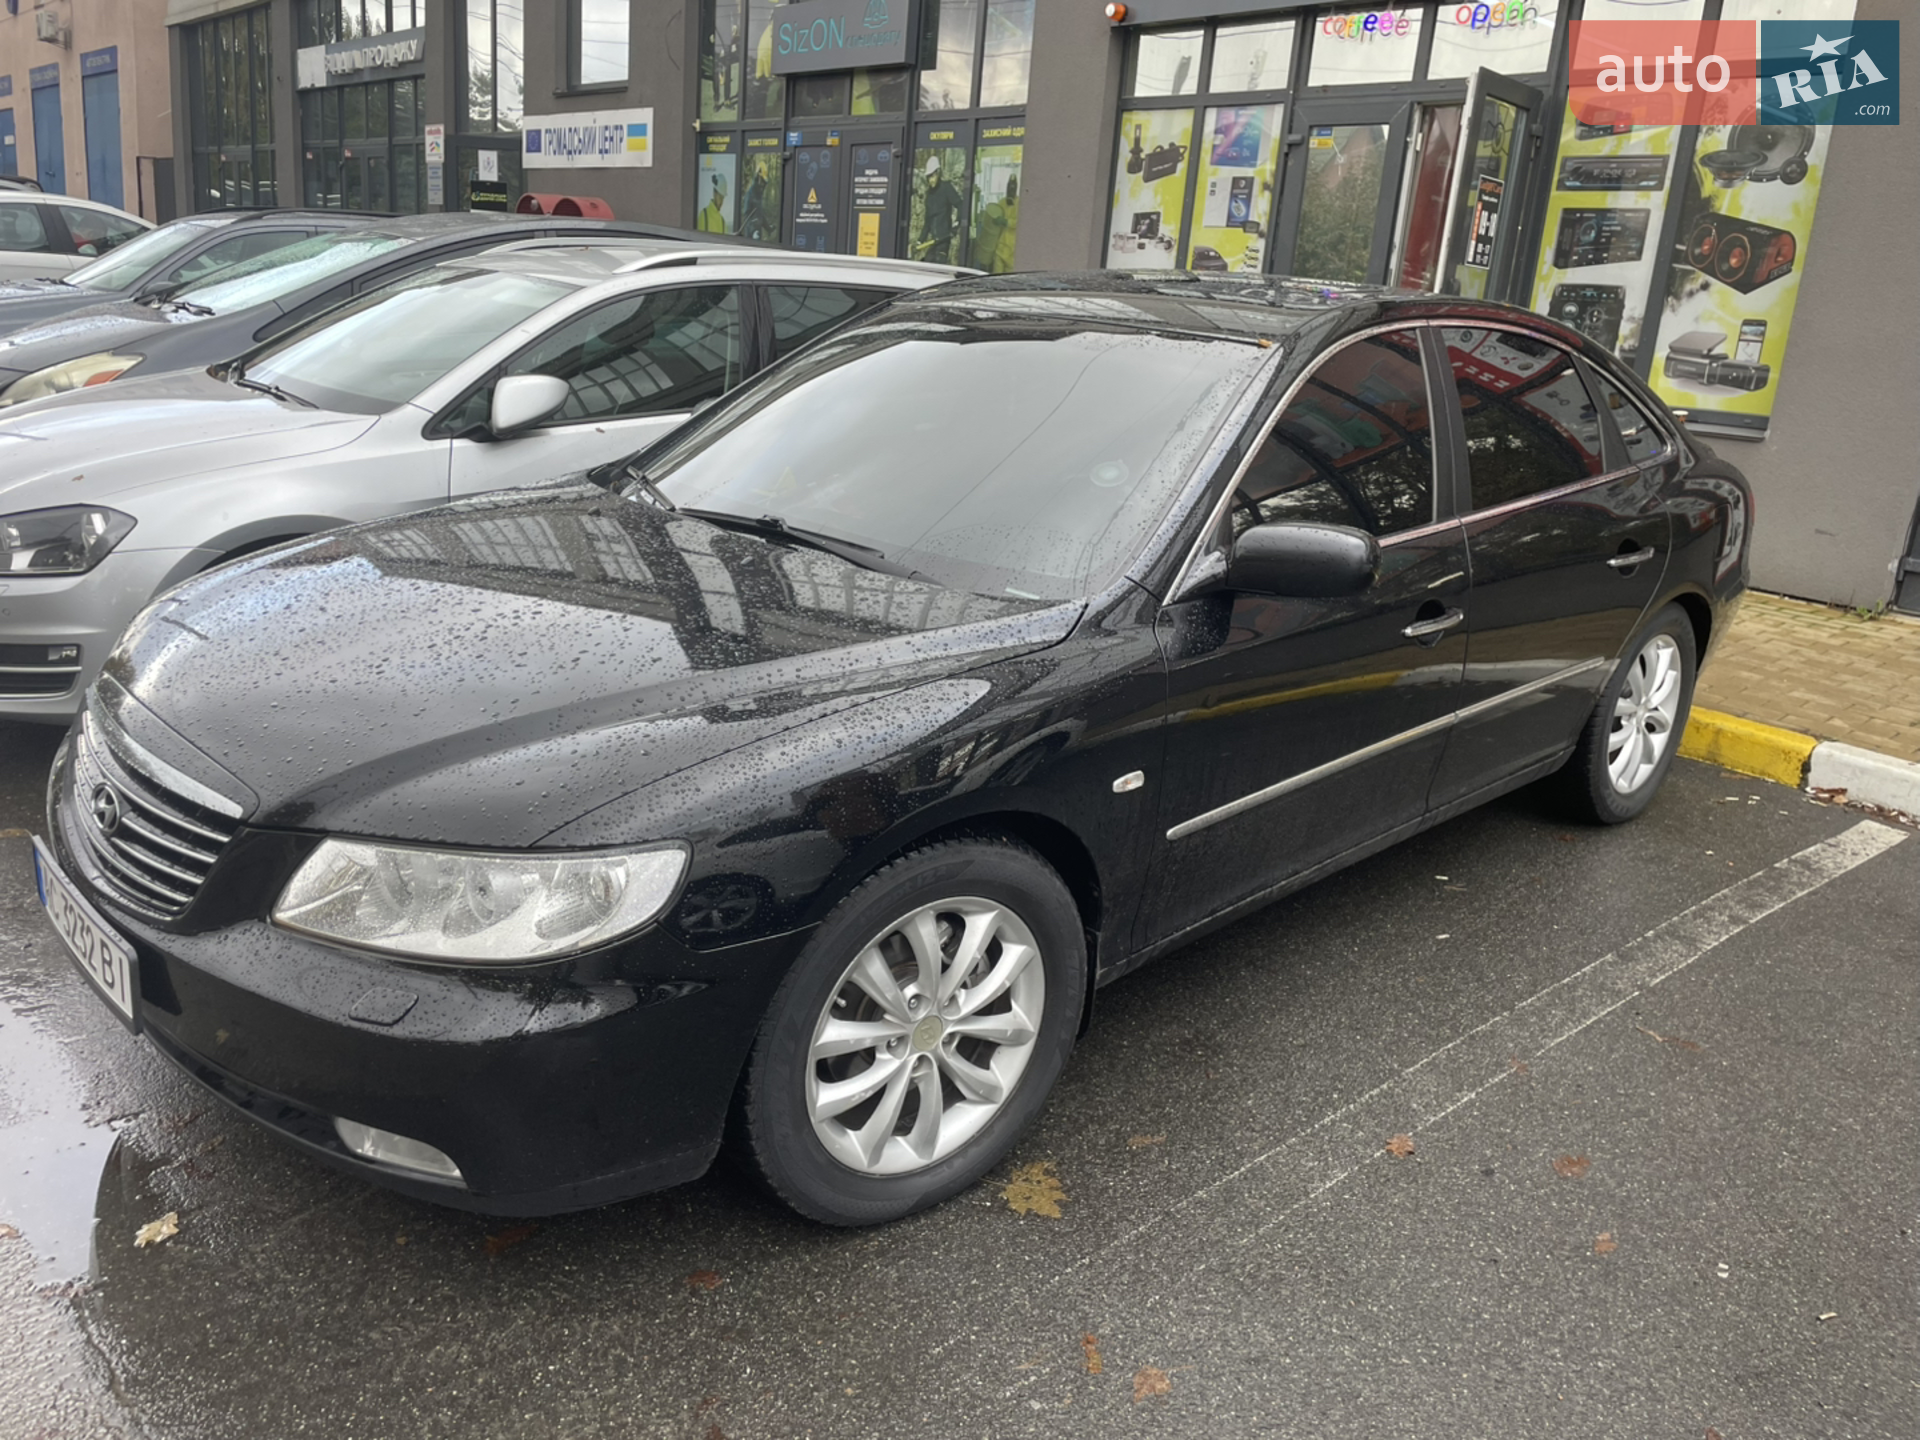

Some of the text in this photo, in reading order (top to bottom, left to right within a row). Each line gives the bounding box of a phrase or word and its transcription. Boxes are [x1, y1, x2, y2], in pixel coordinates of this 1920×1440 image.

[1322, 12, 1394, 38] coffee
[1455, 0, 1523, 30] open
[778, 15, 846, 55] SizON
[361, 39, 419, 69] ПРОДАЖУ
[544, 117, 625, 161] ГРОМАДСЬКИЙ ЦЕНТР
[60, 891, 98, 974] 3232
